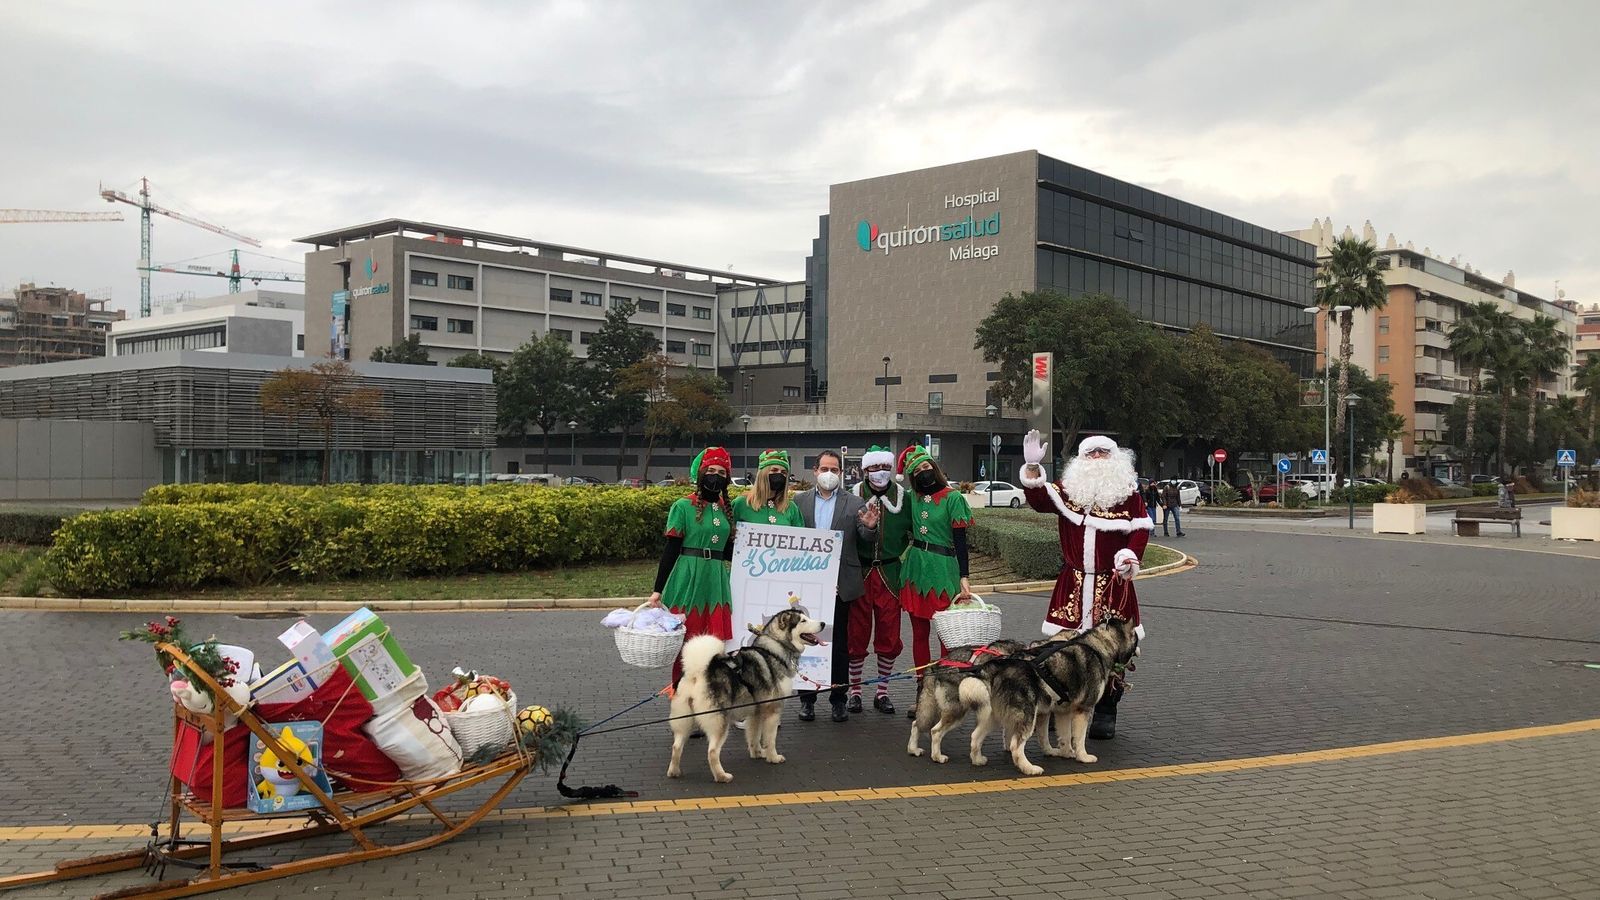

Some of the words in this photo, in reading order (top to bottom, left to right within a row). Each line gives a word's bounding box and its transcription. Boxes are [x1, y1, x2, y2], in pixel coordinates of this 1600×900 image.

[944, 187, 1000, 209] Hospital
[877, 211, 1001, 256] quirónsalud
[949, 244, 999, 261] Málaga
[747, 532, 834, 553] HUELLAS
[741, 548, 759, 568] y
[750, 549, 833, 577] Sonrisas
